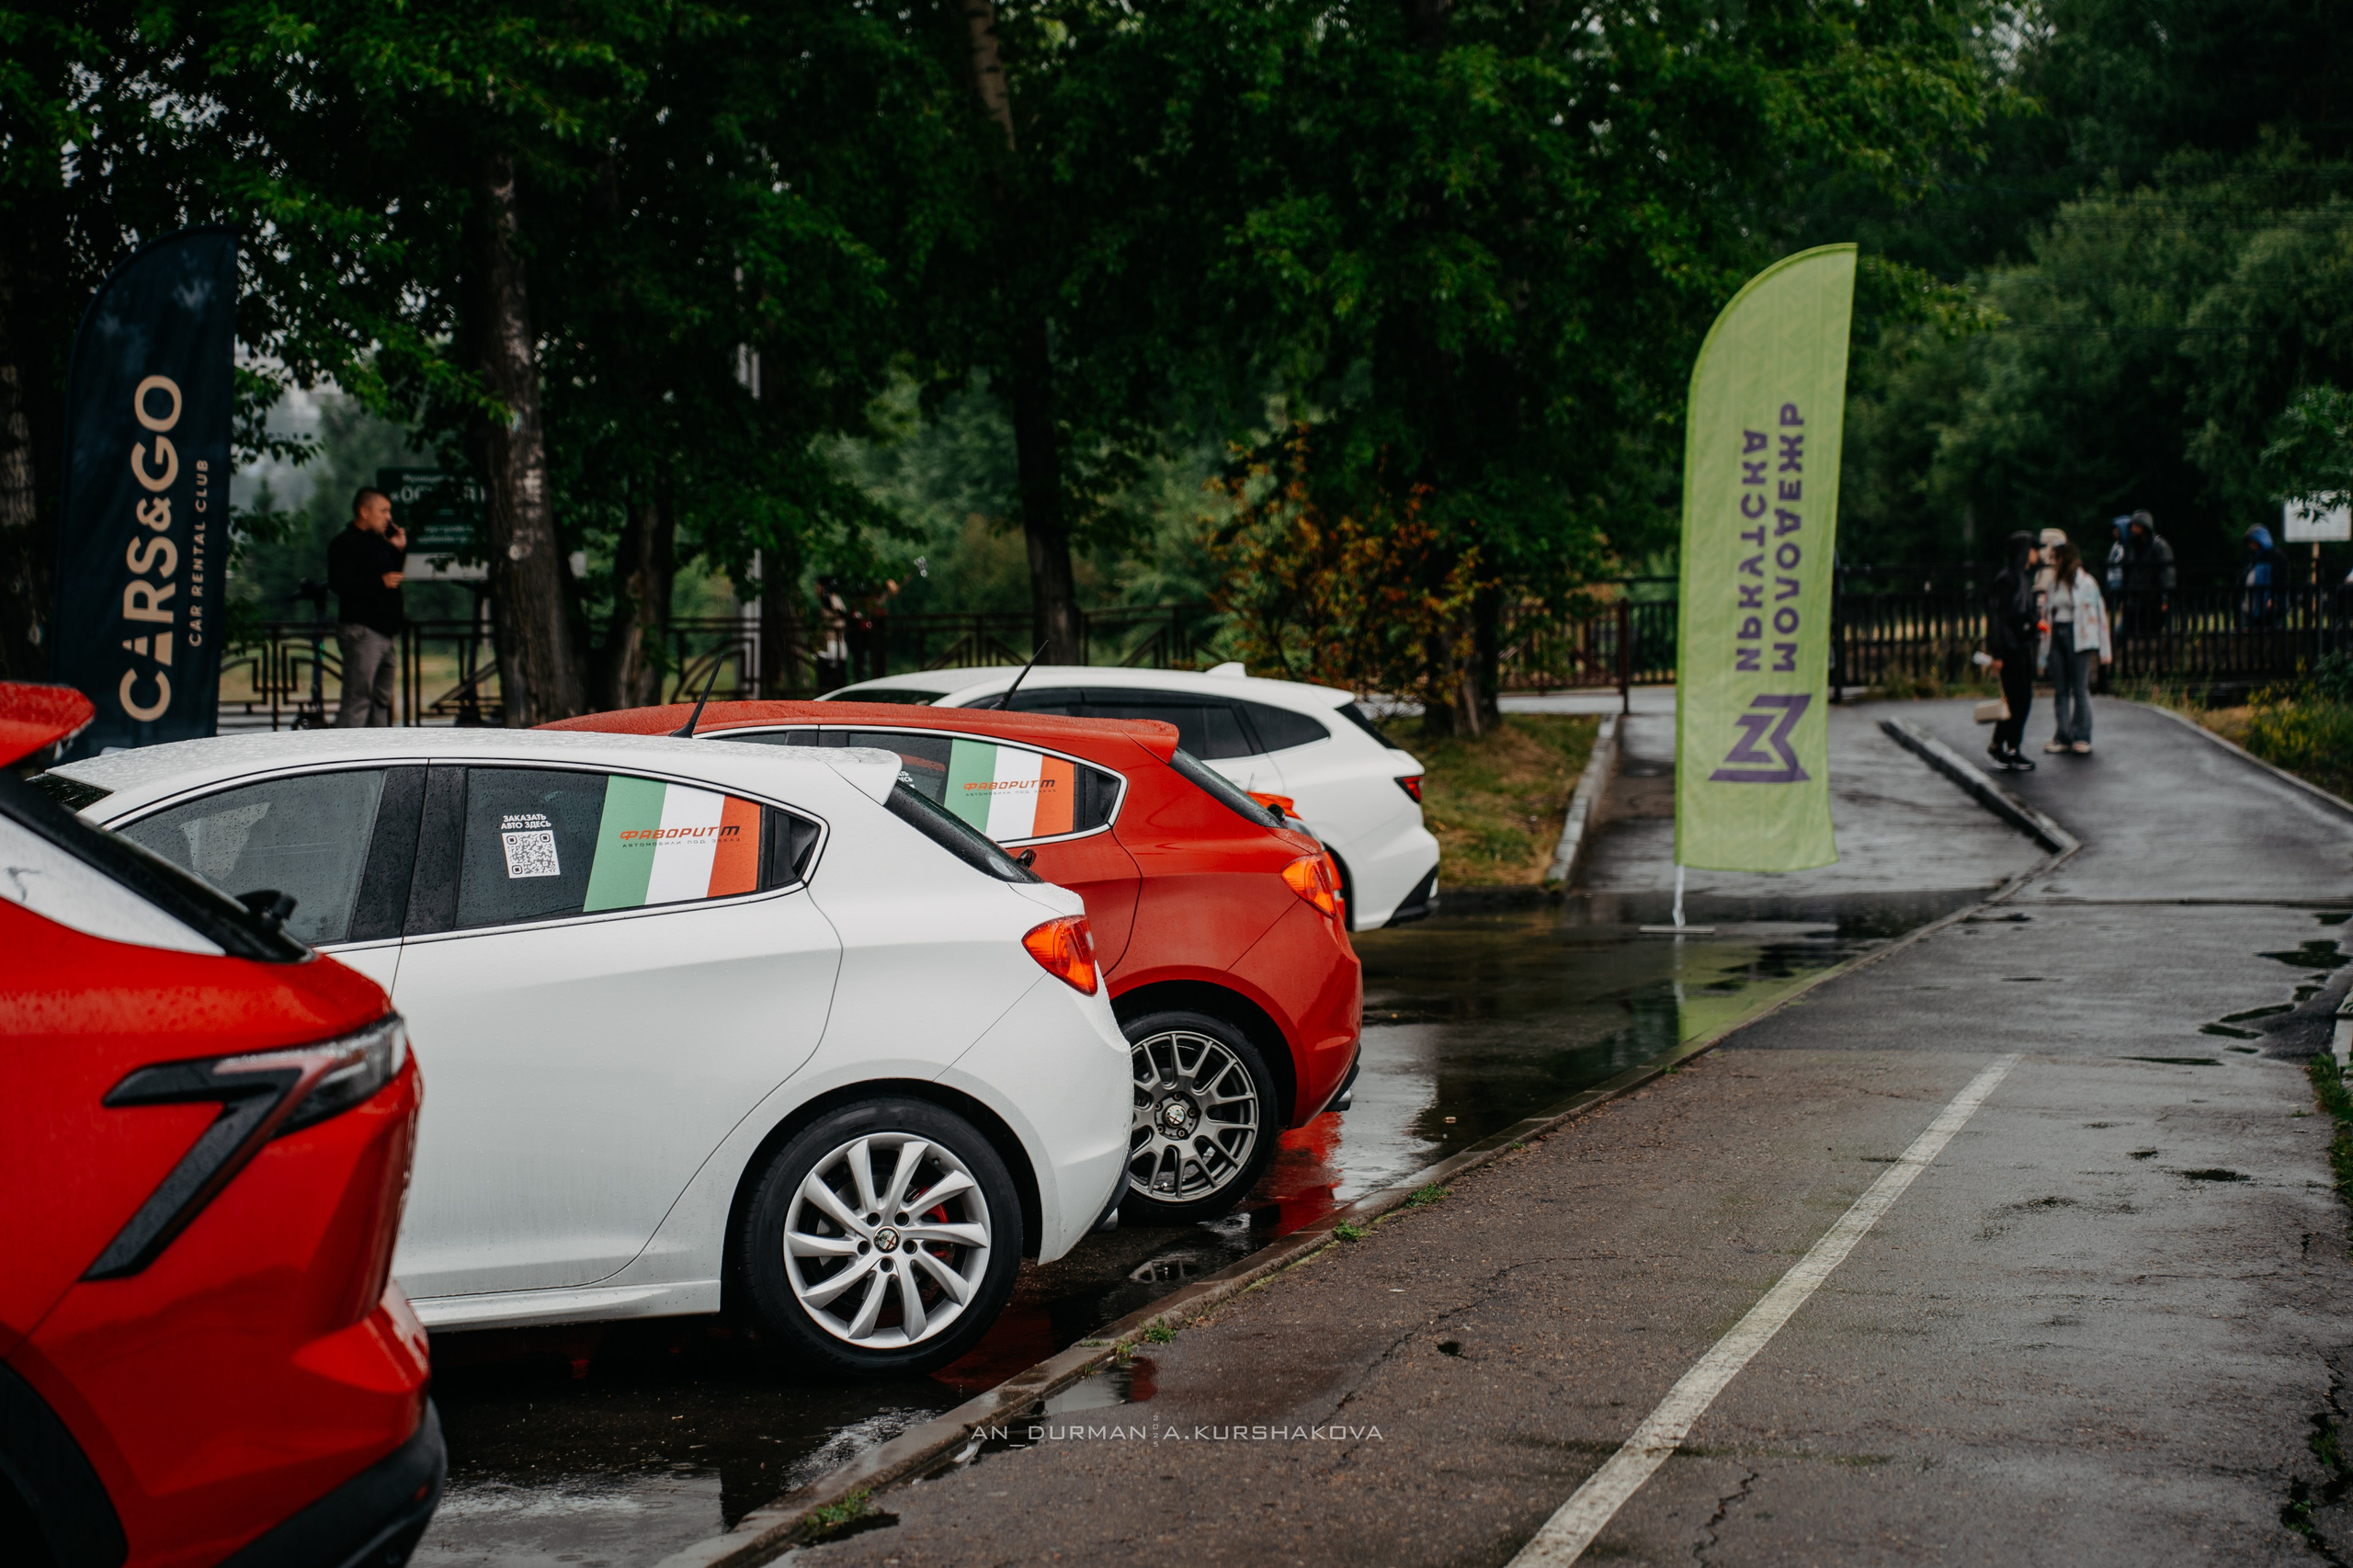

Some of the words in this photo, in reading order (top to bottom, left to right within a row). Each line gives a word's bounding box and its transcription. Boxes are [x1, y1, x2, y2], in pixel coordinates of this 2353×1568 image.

[195, 460, 209, 514] CLUB
[119, 375, 182, 722] CARS&GO
[191, 522, 206, 597] RENTAL
[189, 605, 202, 647] CAR
[500, 822, 523, 830] АВТО
[524, 820, 551, 830] ЗДЕСЬ
[503, 813, 547, 823] ЗАКАЗАТЬ
[621, 840, 682, 848] АВТОМОБИЛИ
